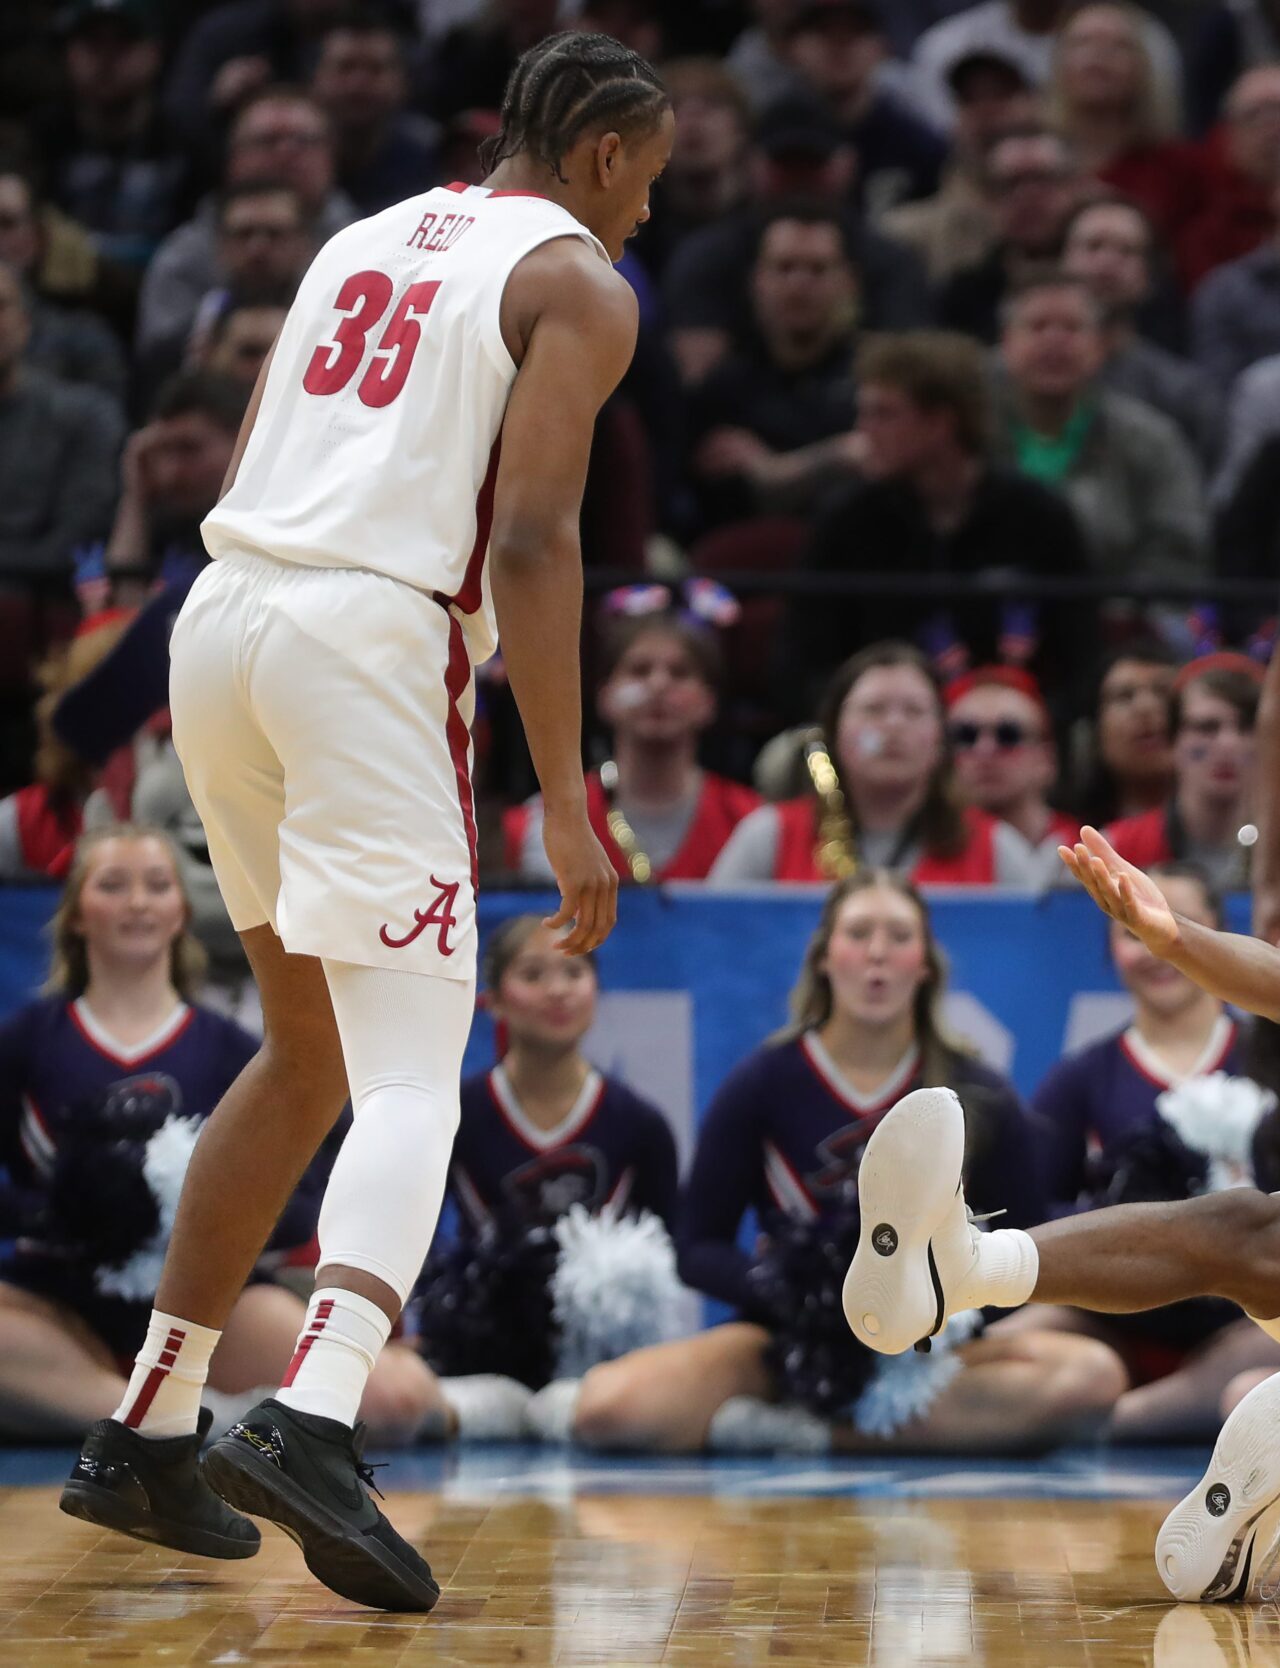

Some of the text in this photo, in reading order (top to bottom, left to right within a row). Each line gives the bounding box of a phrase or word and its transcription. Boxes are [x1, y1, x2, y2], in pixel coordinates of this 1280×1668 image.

[406, 212, 475, 251] REID
[302, 269, 442, 408] 35
[379, 873, 460, 956] A
